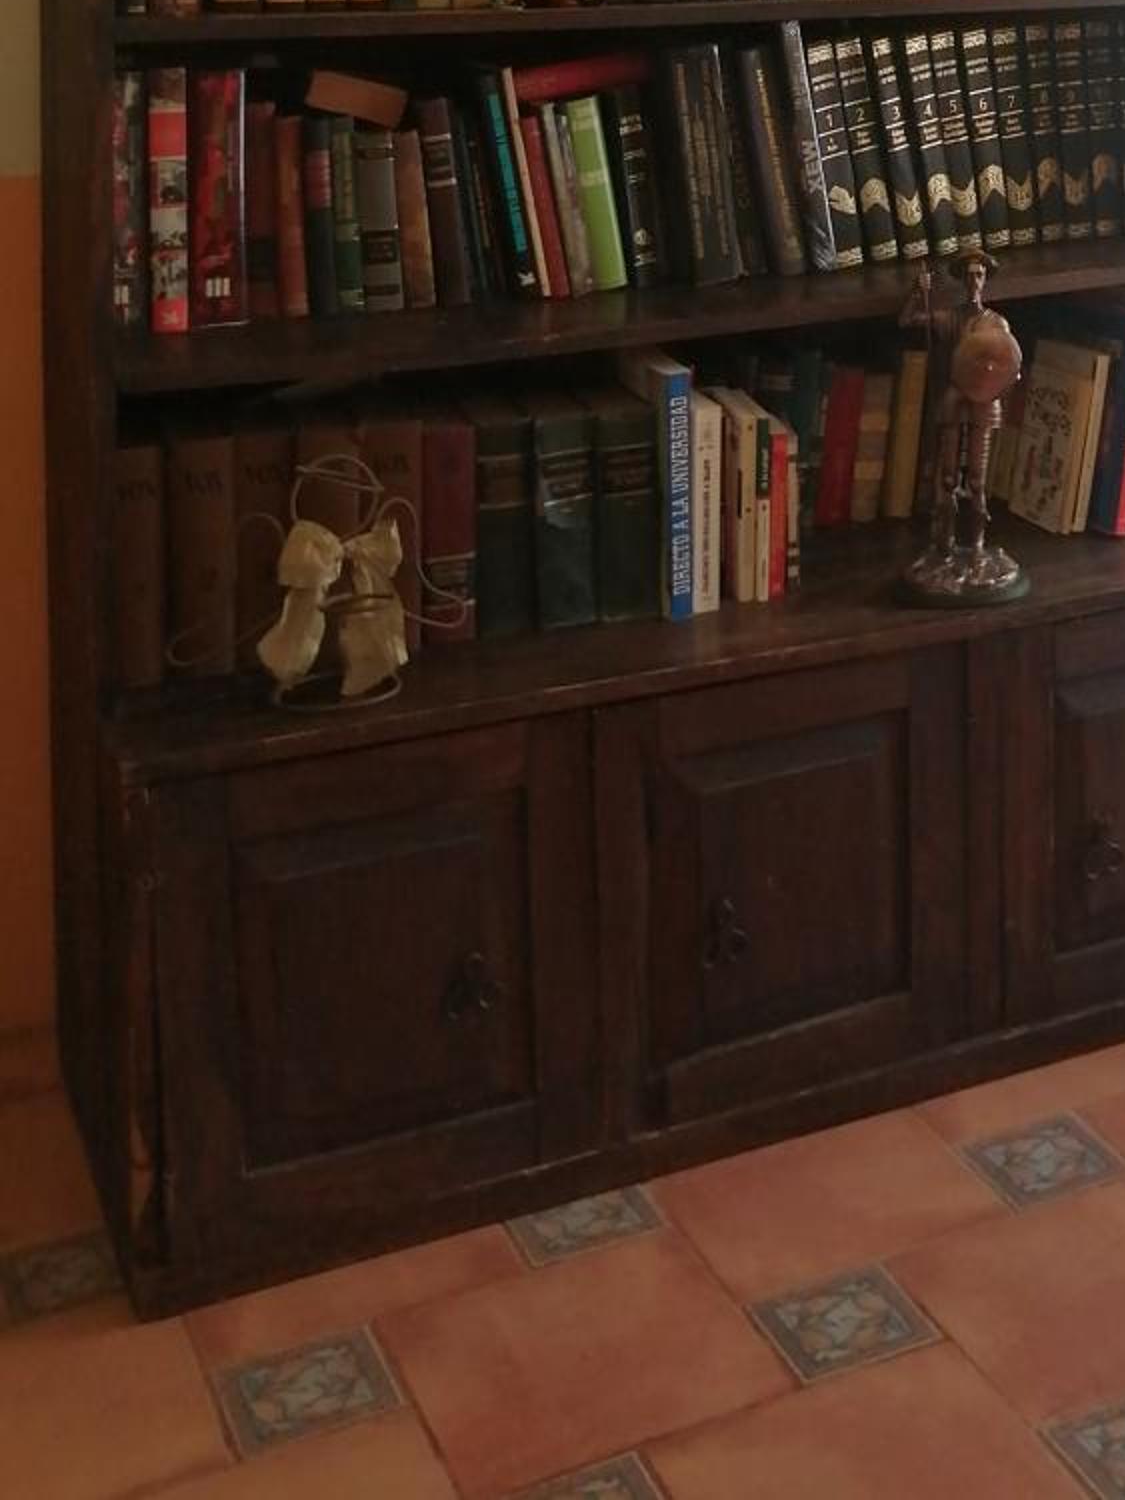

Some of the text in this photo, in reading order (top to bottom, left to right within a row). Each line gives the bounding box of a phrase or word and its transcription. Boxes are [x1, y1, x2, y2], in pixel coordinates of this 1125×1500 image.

[891, 104, 901, 119] 3
[923, 101, 934, 116] 4
[948, 99, 957, 113] 5
[978, 98, 988, 111] 6
[825, 113, 834, 128] 1
[855, 107, 865, 122] 2
[669, 395, 691, 597] DIRECTO A LA UNIVERSIDAD
